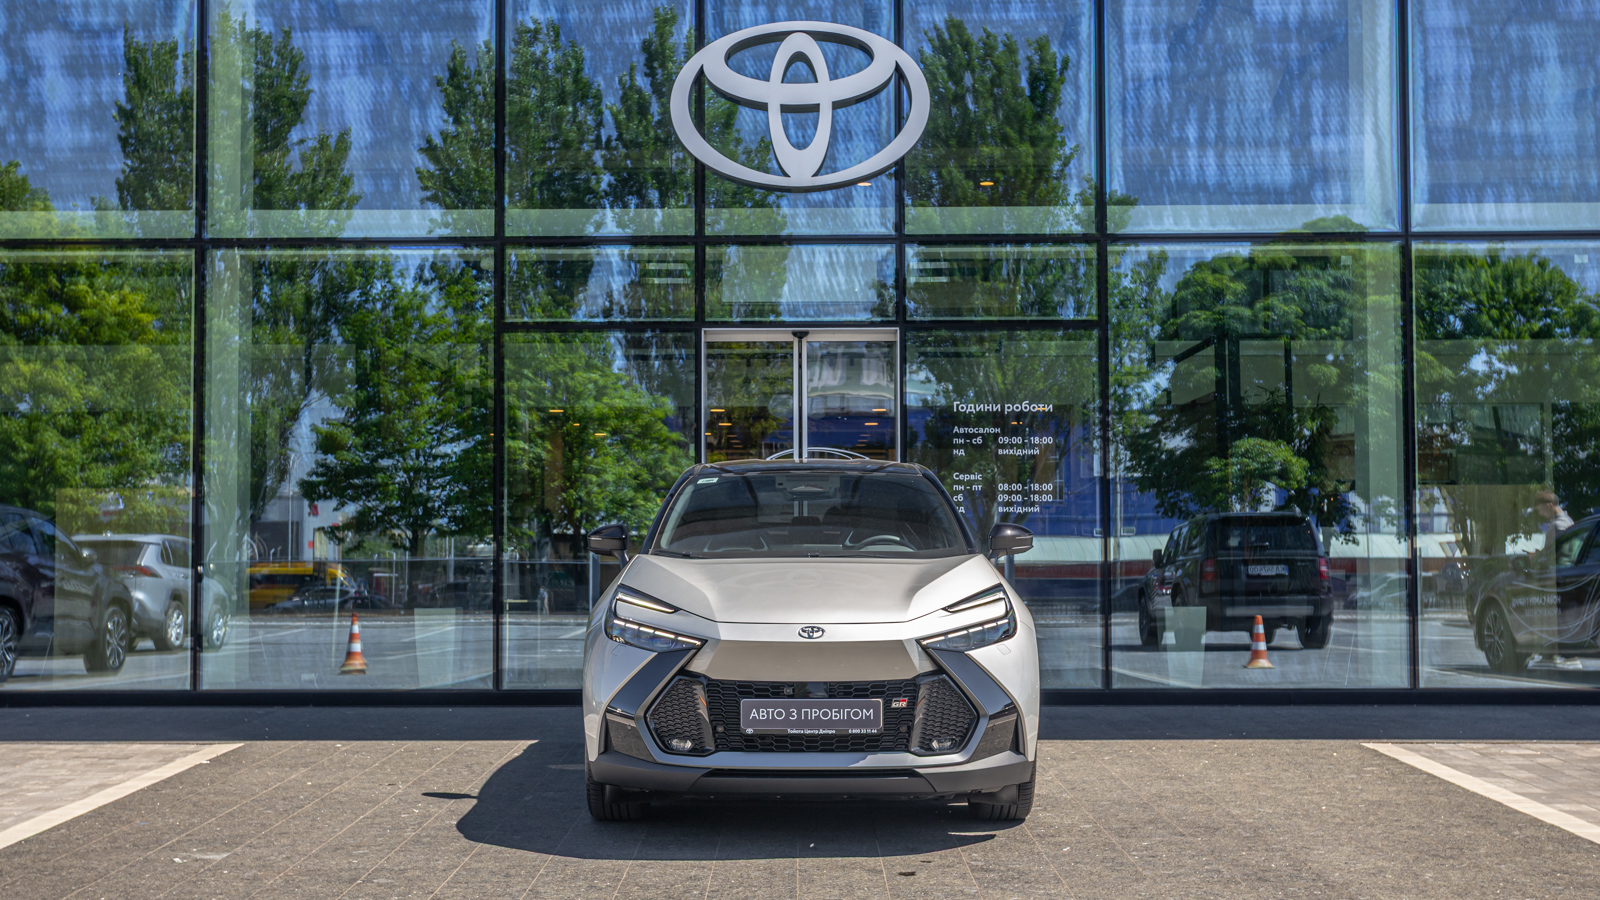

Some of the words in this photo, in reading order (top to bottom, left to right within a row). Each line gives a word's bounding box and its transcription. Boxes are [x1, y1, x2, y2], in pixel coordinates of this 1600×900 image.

[953, 401, 1001, 414] Години
[1004, 401, 1053, 414] роботи
[953, 426, 1001, 434] Автосалон
[972, 436, 983, 444] сб
[998, 436, 1023, 444] 09:00
[1030, 436, 1053, 444] 18:00
[998, 447, 1040, 456] вихідний
[953, 472, 982, 481] Сервіс
[998, 483, 1022, 491] 08:00
[1030, 483, 1053, 491] 18:00
[953, 494, 964, 502] сб
[998, 493, 1022, 502] 09:00
[1030, 493, 1053, 502] 18:00
[998, 505, 1040, 513] вихідний
[749, 708, 786, 720] АВТО
[789, 708, 798, 720] З
[801, 708, 874, 720] ПРОБІГОМ
